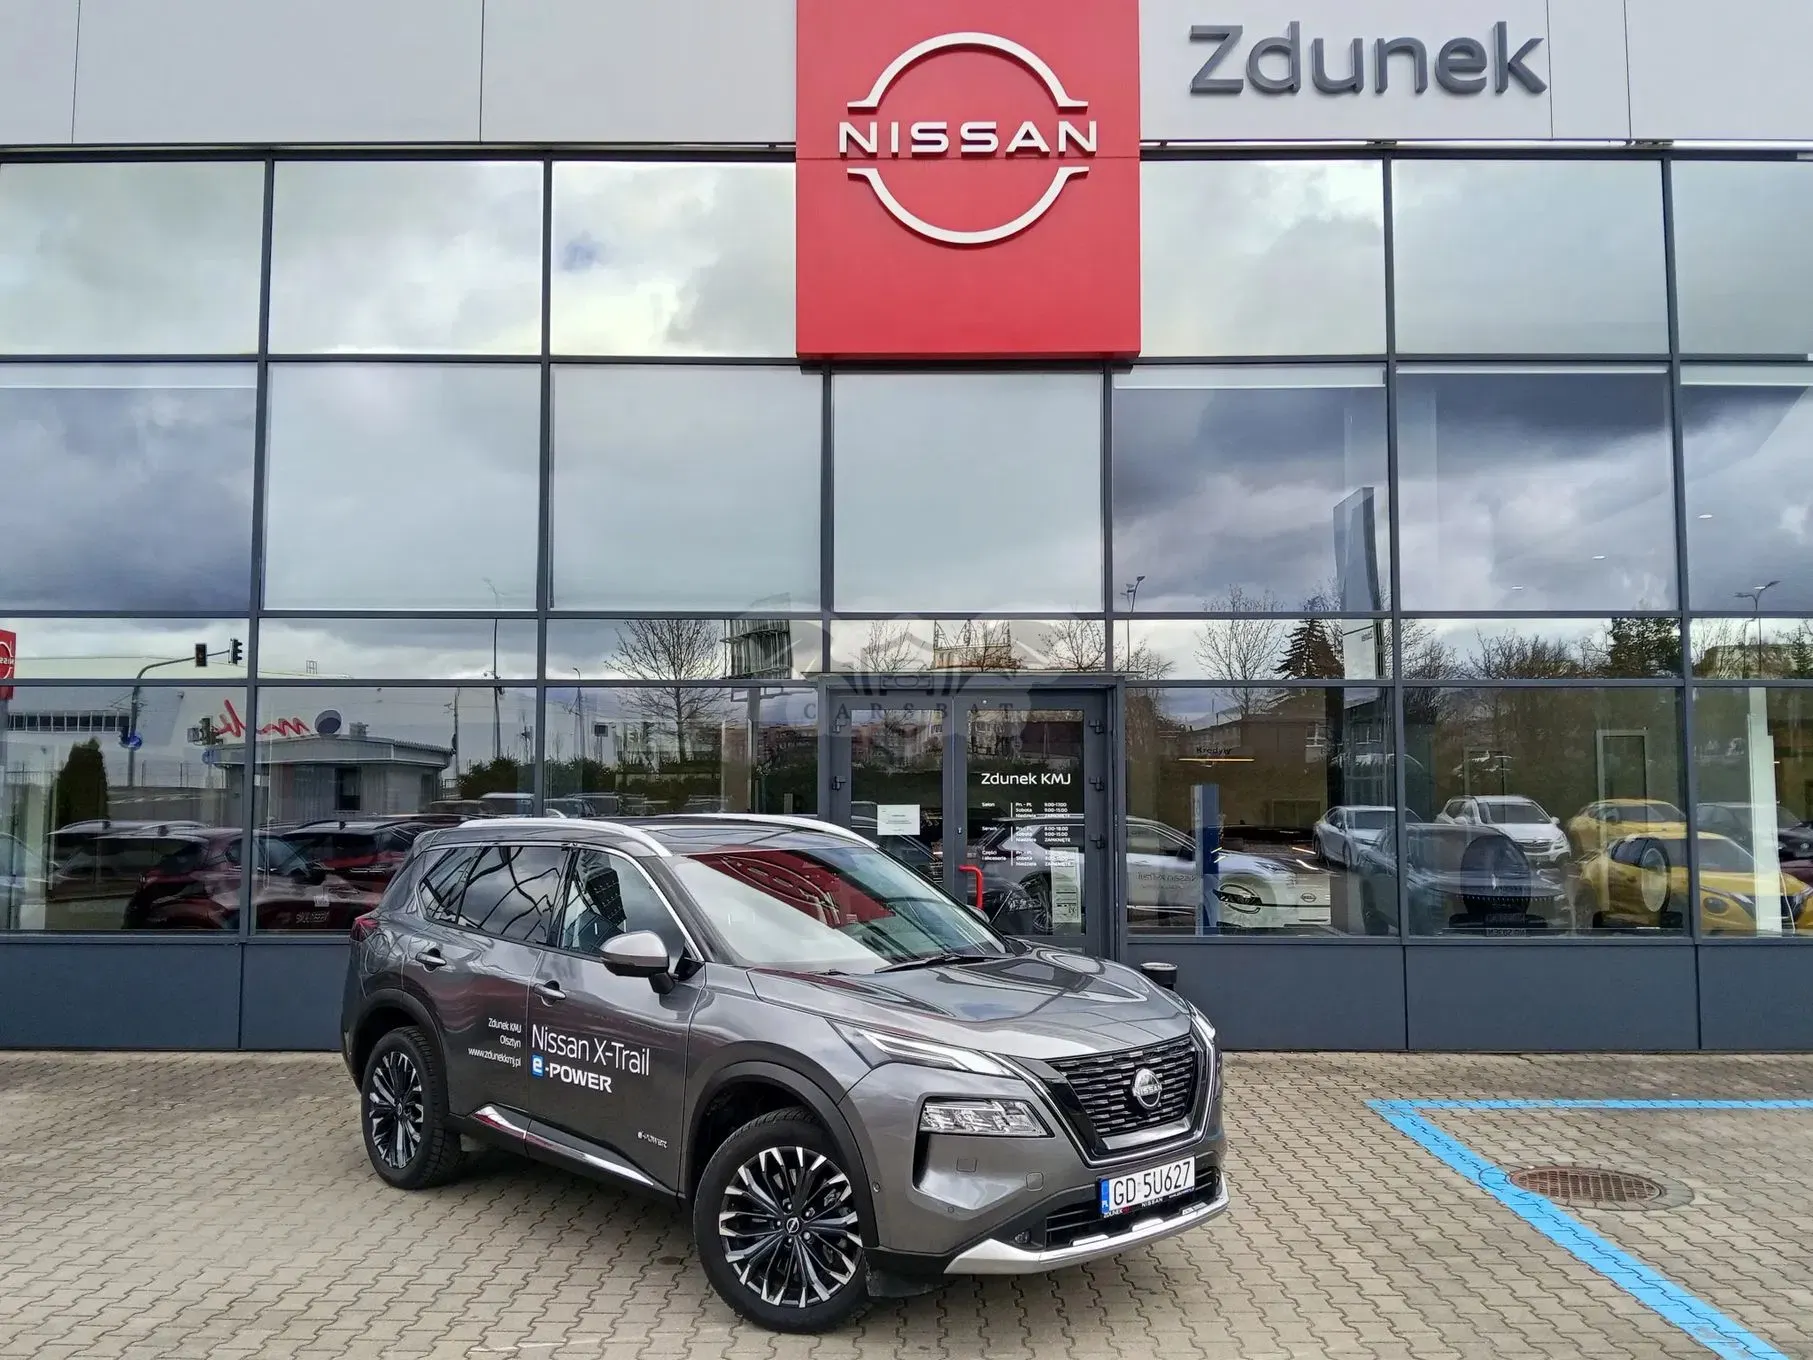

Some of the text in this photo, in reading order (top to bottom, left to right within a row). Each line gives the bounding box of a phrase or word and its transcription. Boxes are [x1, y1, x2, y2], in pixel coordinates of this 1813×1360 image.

[1189, 20, 1548, 96] Zdunek
[838, 120, 1097, 156] NISSAN
[981, 772, 1071, 785] Zdunek KMJ
[488, 1017, 509, 1031] Zdunek
[499, 1034, 521, 1049] Olsztyn
[532, 1023, 650, 1076] Nissan X-Trail
[1132, 1083, 1163, 1097] NISSAN
[1113, 1160, 1191, 1206] GD 5U627
[1141, 1197, 1164, 1208] NISSAN
